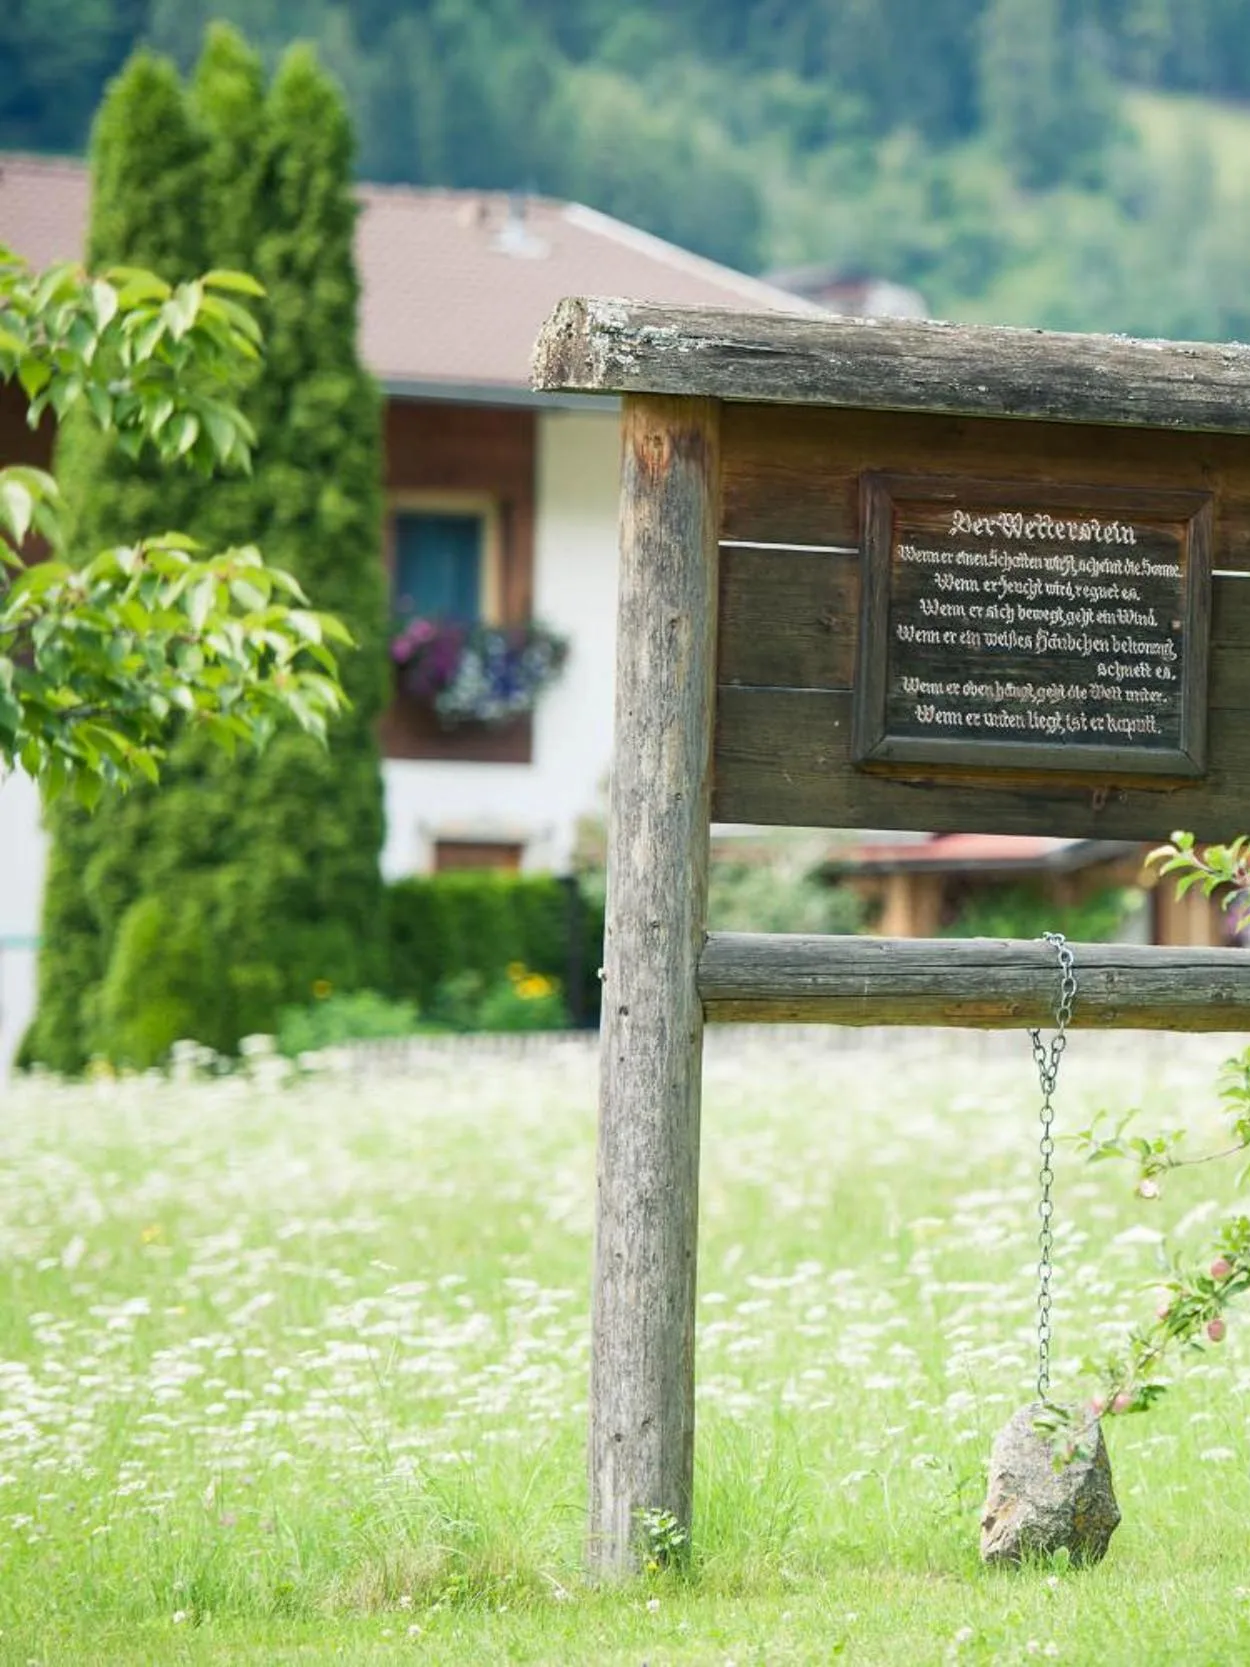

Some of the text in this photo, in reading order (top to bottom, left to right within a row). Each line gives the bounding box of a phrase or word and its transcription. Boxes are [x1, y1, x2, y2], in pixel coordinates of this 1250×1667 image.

[948, 510, 1137, 545] Der Wetterstein
[898, 544, 940, 563] Wenn
[941, 552, 954, 563] er
[956, 551, 987, 567] einen
[1123, 558, 1141, 576] die
[934, 573, 980, 592] Wenn
[983, 579, 998, 592] er
[920, 598, 966, 617] Wenn
[969, 605, 984, 618] er
[985, 603, 1014, 624] sich
[1066, 607, 1095, 628] geht
[1096, 608, 1116, 624] ein
[1116, 607, 1158, 627] Wind.
[897, 624, 941, 643] Wenn
[943, 630, 957, 644] er
[959, 629, 980, 648] ein
[1097, 661, 1152, 681] schneit
[902, 676, 944, 694] Wenn
[946, 681, 960, 695] er
[962, 680, 994, 699] oben
[1036, 683, 1065, 705] geht
[1067, 684, 1088, 699] die
[1088, 683, 1122, 700] Welt
[915, 704, 962, 725] Wenn
[965, 711, 981, 726] er
[983, 709, 1026, 729] unten
[1066, 712, 1088, 732] ist
[1089, 716, 1104, 730] er
